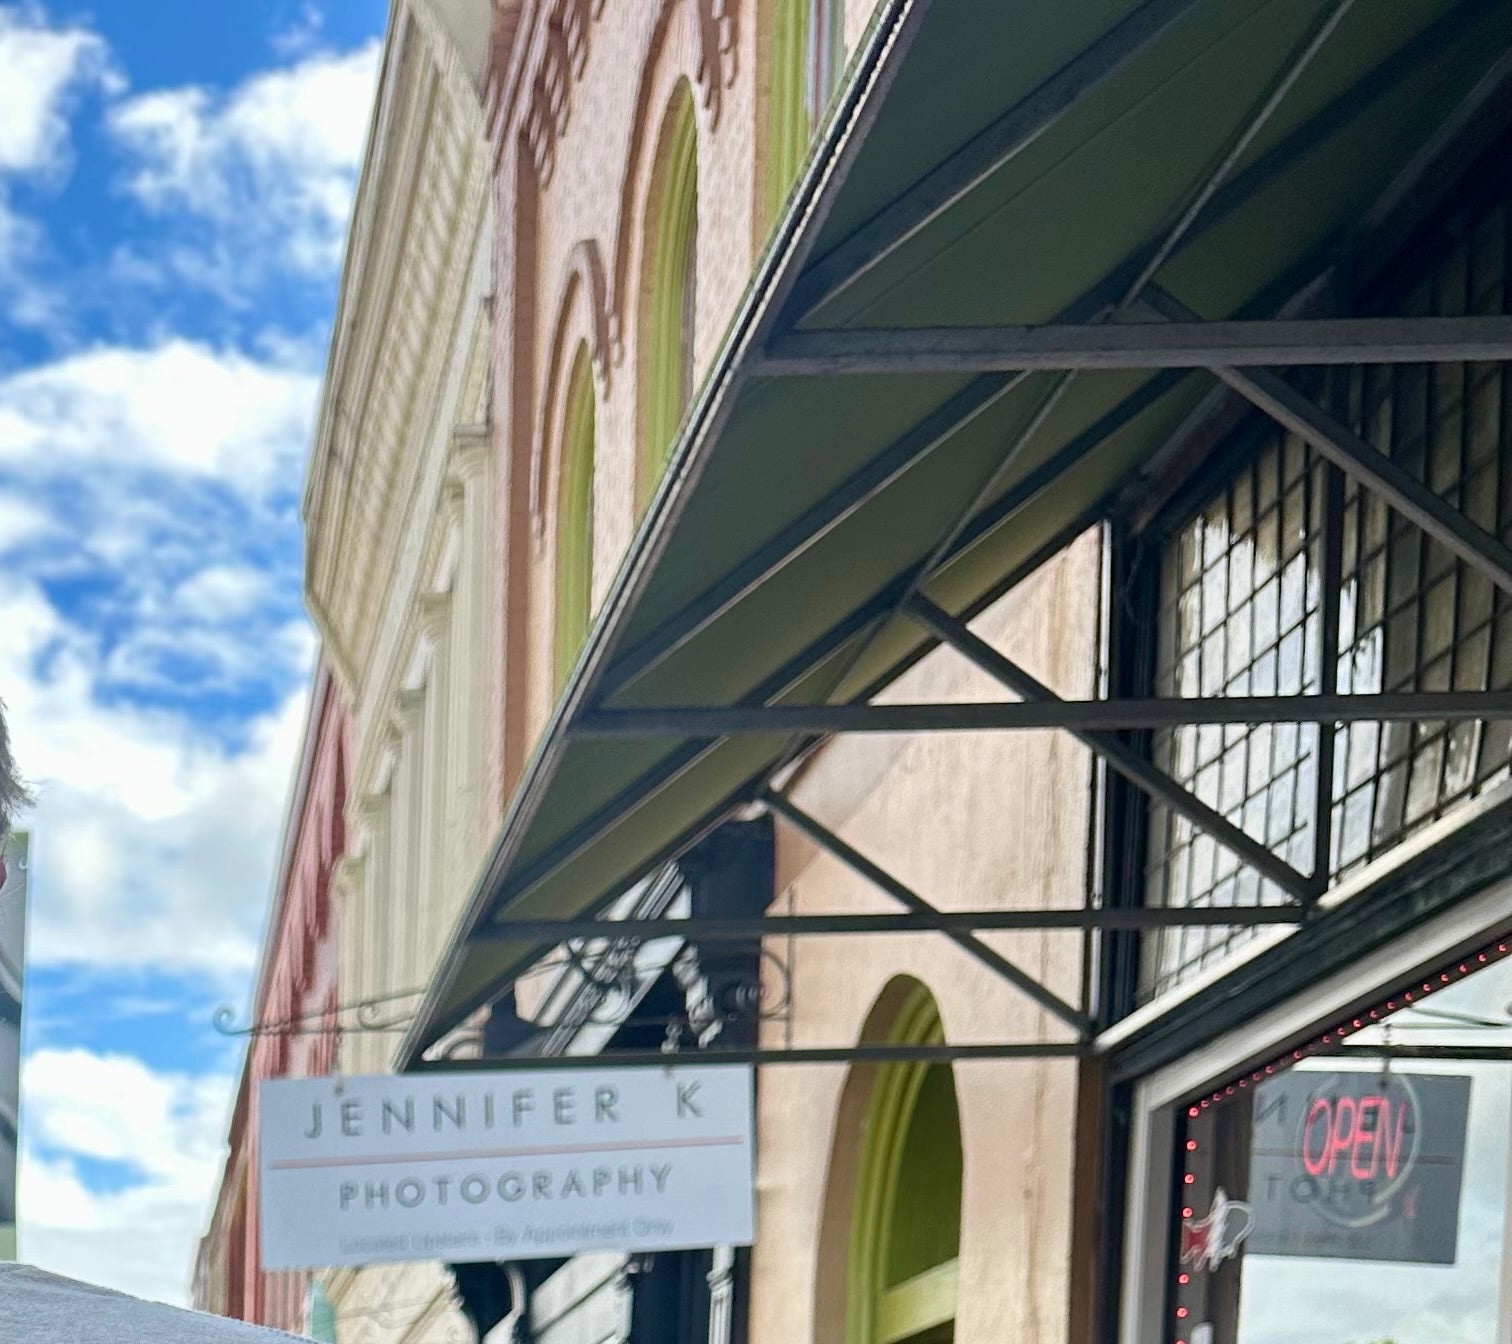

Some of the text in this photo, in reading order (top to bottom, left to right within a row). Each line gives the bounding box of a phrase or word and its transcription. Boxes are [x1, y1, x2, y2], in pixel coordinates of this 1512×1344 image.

[304, 1079, 704, 1140] JENNIFER K
[1303, 1095, 1408, 1179] OPEN
[339, 1162, 674, 1211] PHOTOGRAPHY
